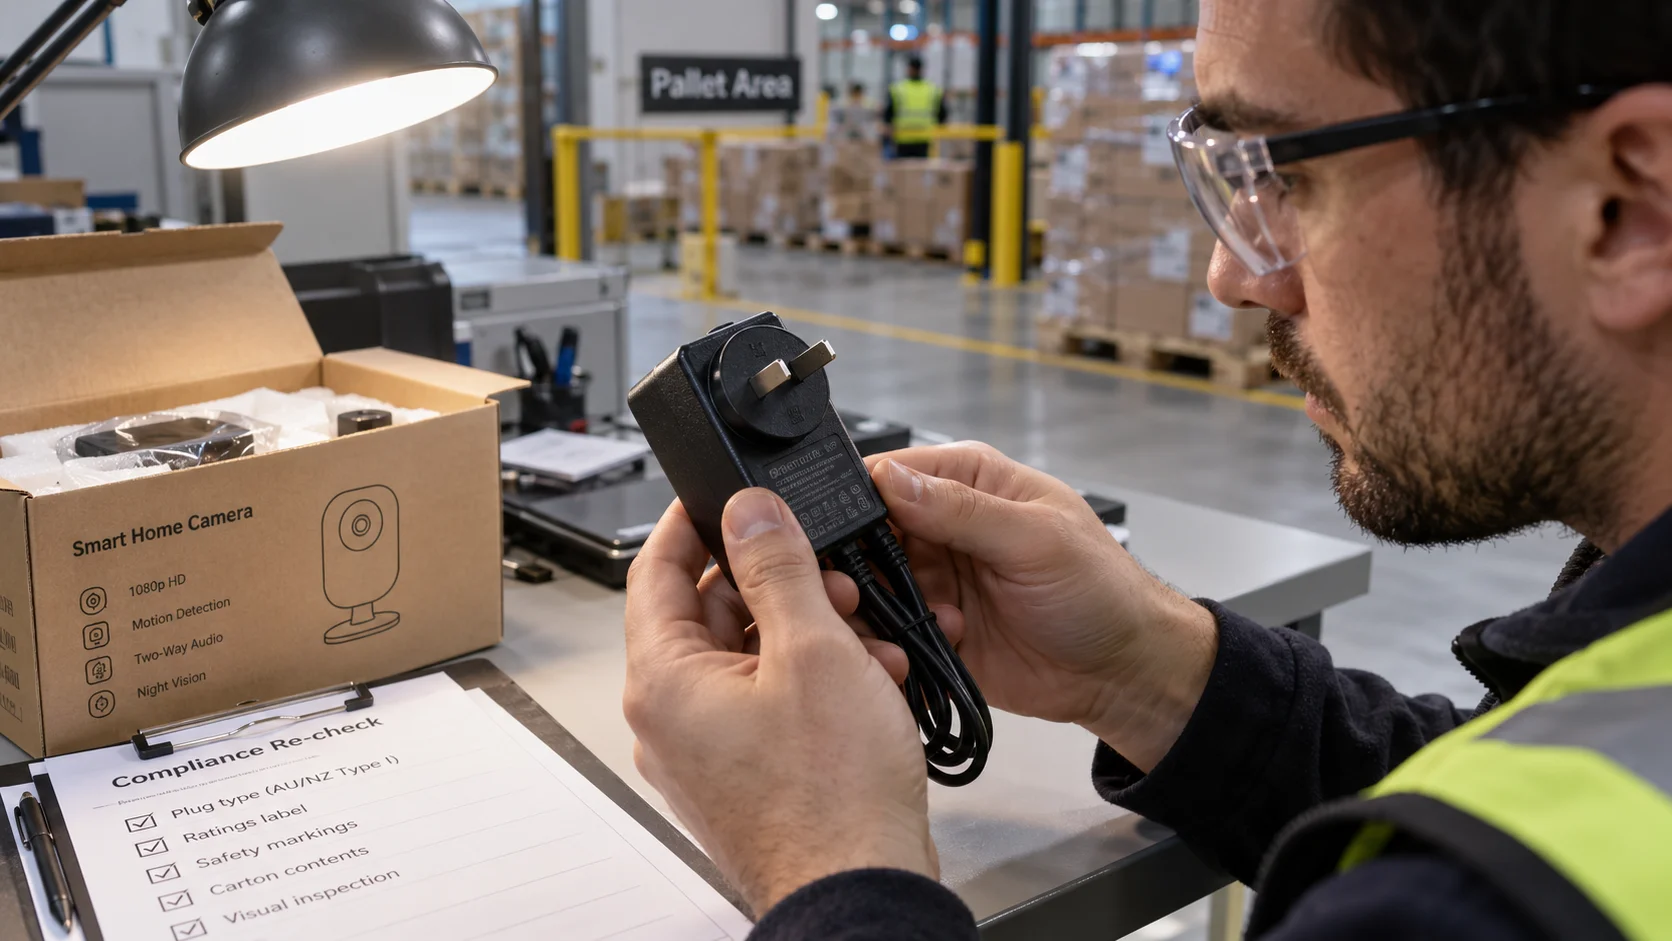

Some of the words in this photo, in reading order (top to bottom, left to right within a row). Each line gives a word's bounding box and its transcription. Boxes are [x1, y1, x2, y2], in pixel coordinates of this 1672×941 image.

[651, 66, 727, 99] Pallet
[731, 67, 793, 99] Area
[72, 532, 127, 557] Smart
[131, 521, 183, 544] Home
[188, 506, 253, 531] Camera
[129, 580, 165, 597] 1080p
[168, 573, 186, 588] HD
[132, 612, 173, 631] Motion
[176, 598, 231, 620] Detection
[134, 642, 188, 665] Two-Way
[191, 632, 224, 650] Audio
[137, 681, 169, 698] Night
[171, 670, 206, 688] Vision
[112, 747, 264, 788] Compliance
[269, 717, 384, 751] Re-check
[171, 802, 215, 819] Plug
[218, 791, 260, 808] type
[265, 771, 334, 796] (AU/NZ
[335, 760, 382, 776] Type
[183, 818, 257, 843] Ratings
[260, 803, 308, 823] label
[196, 845, 260, 869] Safety
[266, 819, 358, 850] markings
[209, 871, 279, 896] Carton
[284, 845, 370, 876] contents
[223, 899, 289, 925] Visual
[292, 869, 401, 906] inspection
